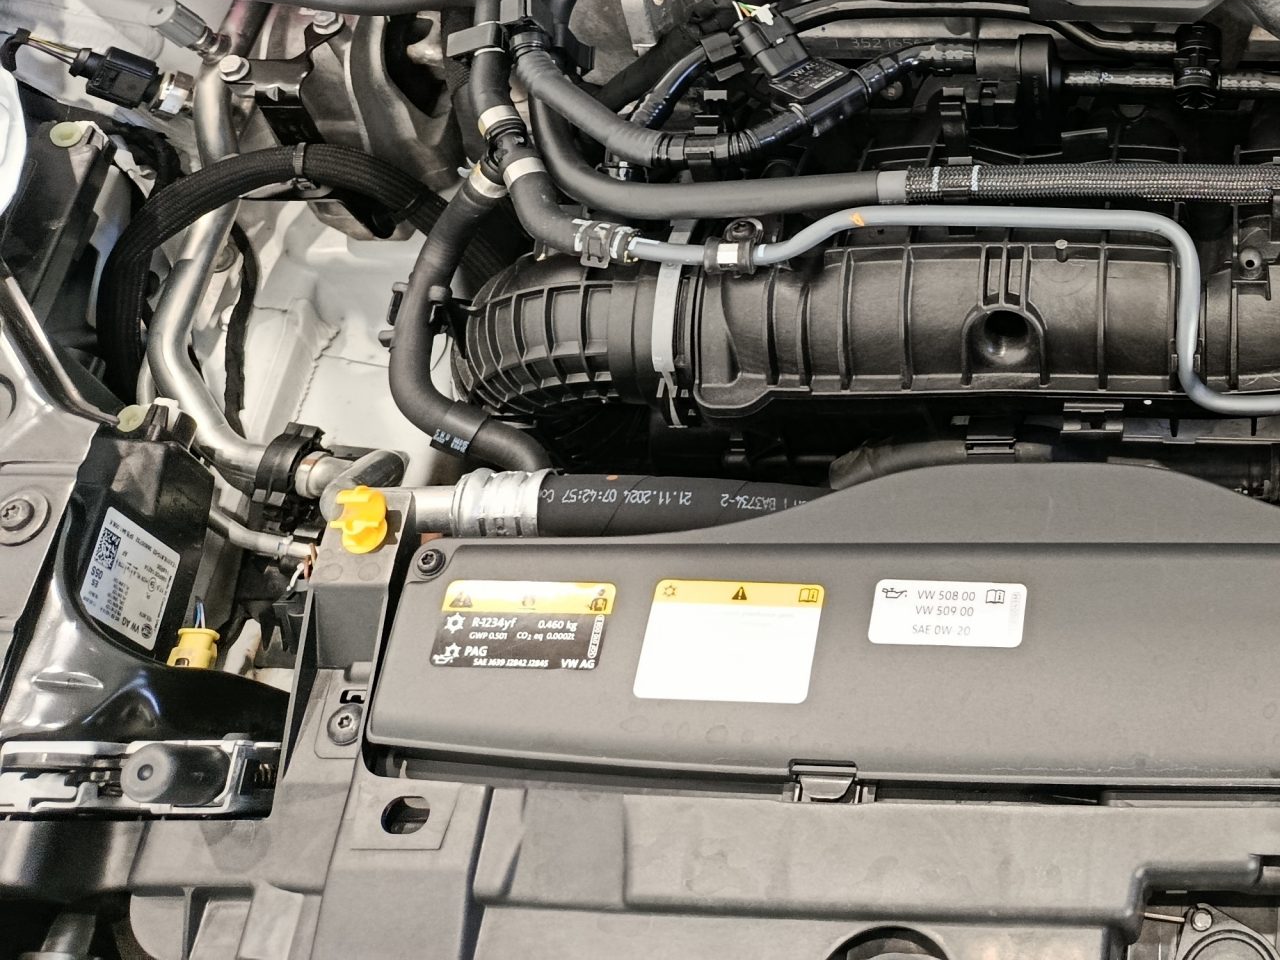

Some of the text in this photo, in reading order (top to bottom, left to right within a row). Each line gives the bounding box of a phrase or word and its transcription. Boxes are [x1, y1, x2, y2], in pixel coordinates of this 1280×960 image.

[561, 488, 618, 504] 07:42:57
[623, 489, 693, 505] 21.11.2024
[720, 493, 776, 511] BA3734-2
[917, 589, 976, 602] VW 508 00
[915, 605, 974, 617] VW 509 00
[121, 616, 131, 628] AG
[130, 622, 140, 634] VW
[471, 616, 578, 631] R-1234yf 0.460 kg
[912, 624, 931, 635] SAE
[488, 632, 508, 640] 0.501
[533, 633, 544, 642] eq
[464, 645, 488, 657] PAG
[473, 658, 488, 666] SAE
[561, 658, 580, 669] VW
[580, 659, 595, 669] AG
